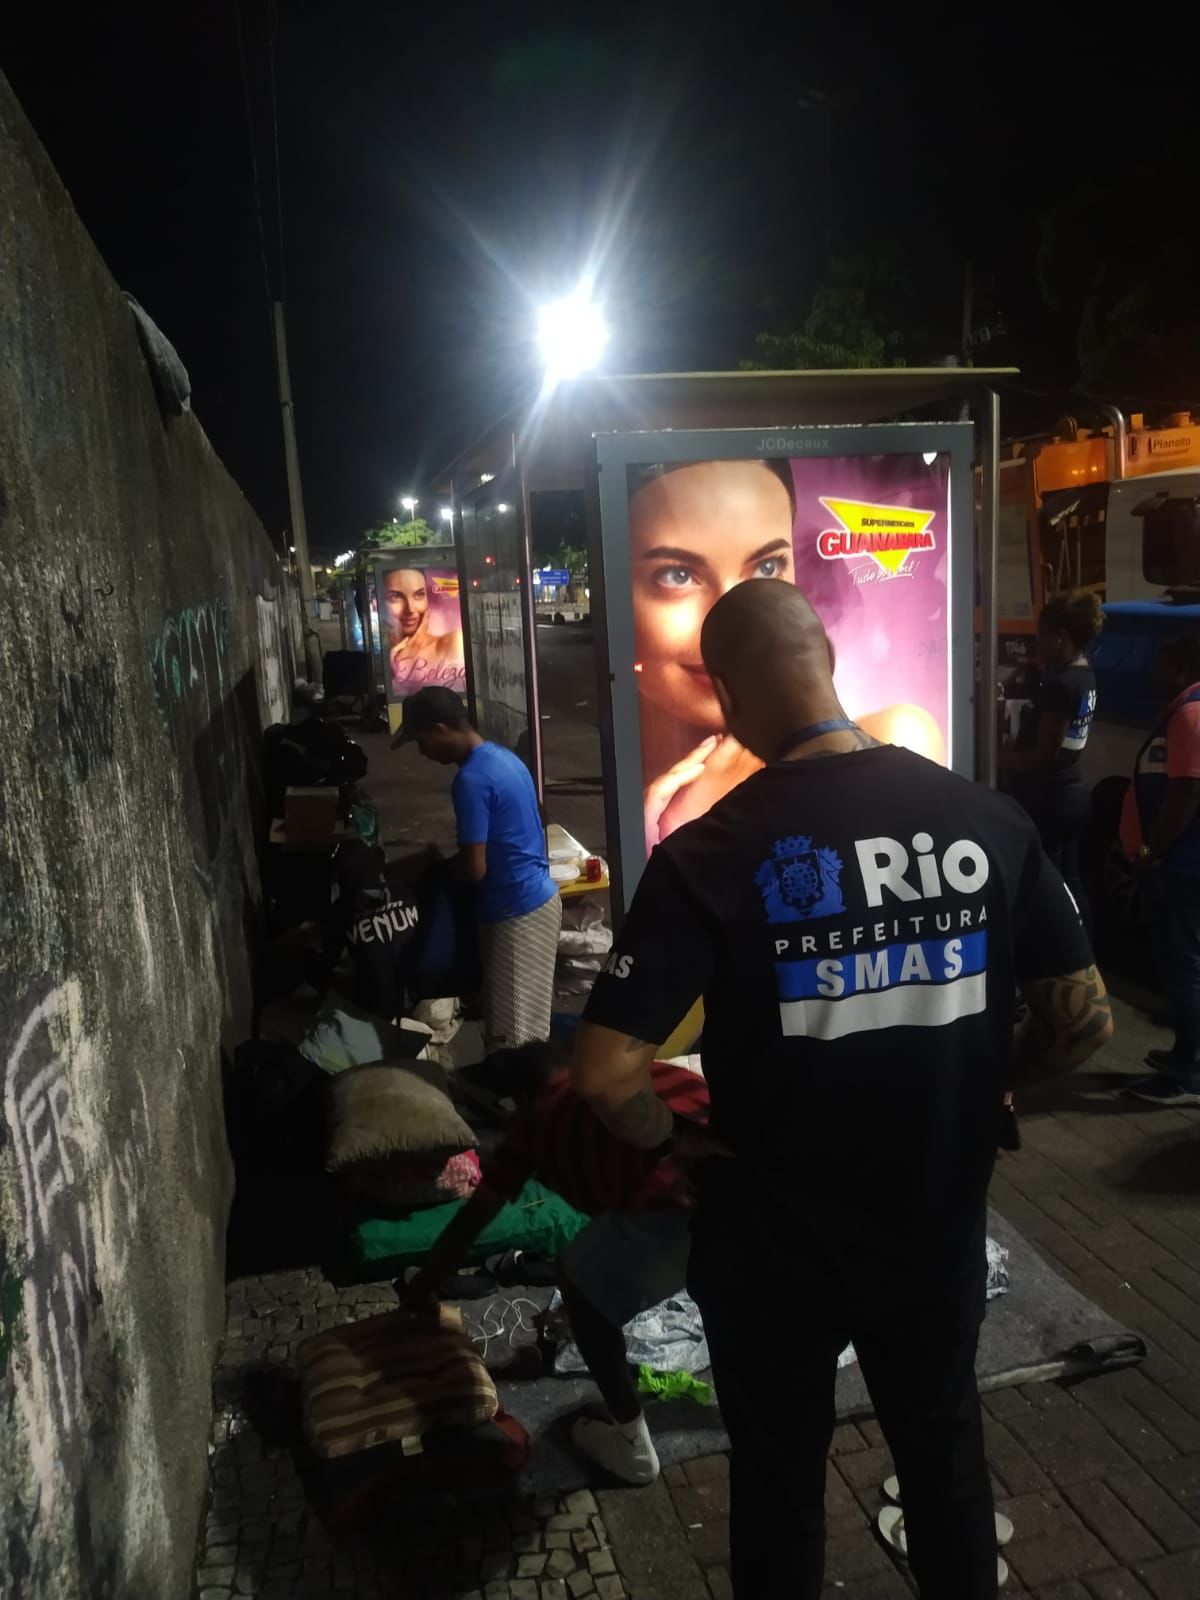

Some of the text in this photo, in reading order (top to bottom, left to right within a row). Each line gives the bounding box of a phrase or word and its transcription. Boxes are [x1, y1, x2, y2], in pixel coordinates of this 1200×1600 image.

[756, 437, 829, 450] JCDecaux
[819, 531, 934, 557] GUANABARA
[848, 562, 874, 586] Tudo
[854, 832, 989, 907] Rio
[346, 905, 419, 944] VENUM
[775, 905, 987, 955] PREFEITURA
[816, 938, 963, 997] SMAS
